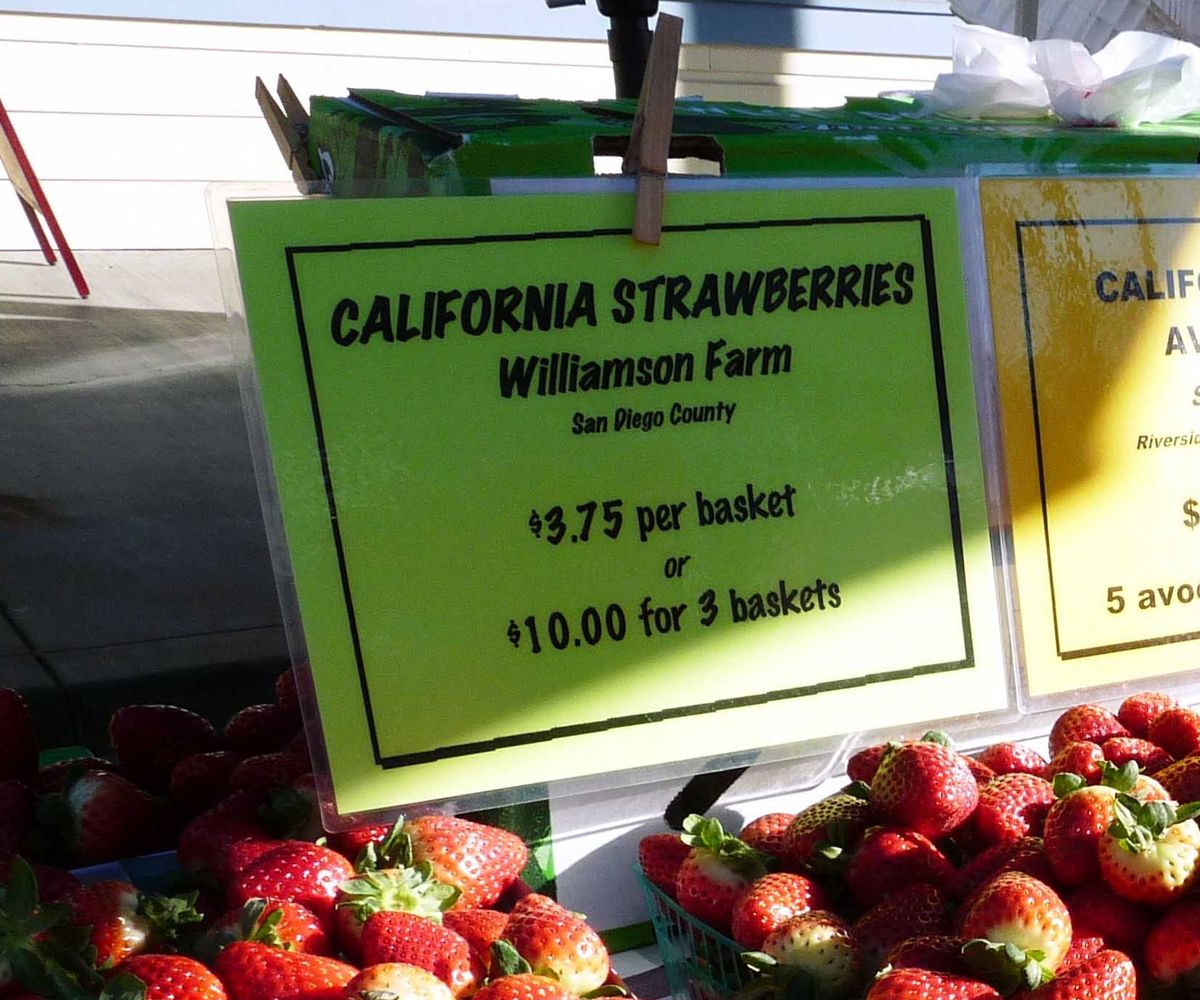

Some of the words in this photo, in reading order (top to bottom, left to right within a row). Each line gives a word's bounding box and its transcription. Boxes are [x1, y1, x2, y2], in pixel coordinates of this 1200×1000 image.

[331, 281, 598, 347] CALIFORNIA
[611, 262, 915, 325] STRAWBERRIES
[499, 350, 694, 399] Williamson
[704, 338, 792, 381] Farm
[572, 411, 608, 435] San
[614, 406, 665, 433] Diego
[669, 401, 737, 428] County
[529, 499, 623, 545] $3.75
[636, 502, 687, 541] per
[695, 484, 796, 528] basket
[664, 554, 691, 579] or
[507, 603, 627, 654] $10.00
[638, 596, 687, 637] for
[697, 589, 719, 627] 3
[729, 577, 842, 623] baskets
[1106, 585, 1126, 615] 5
